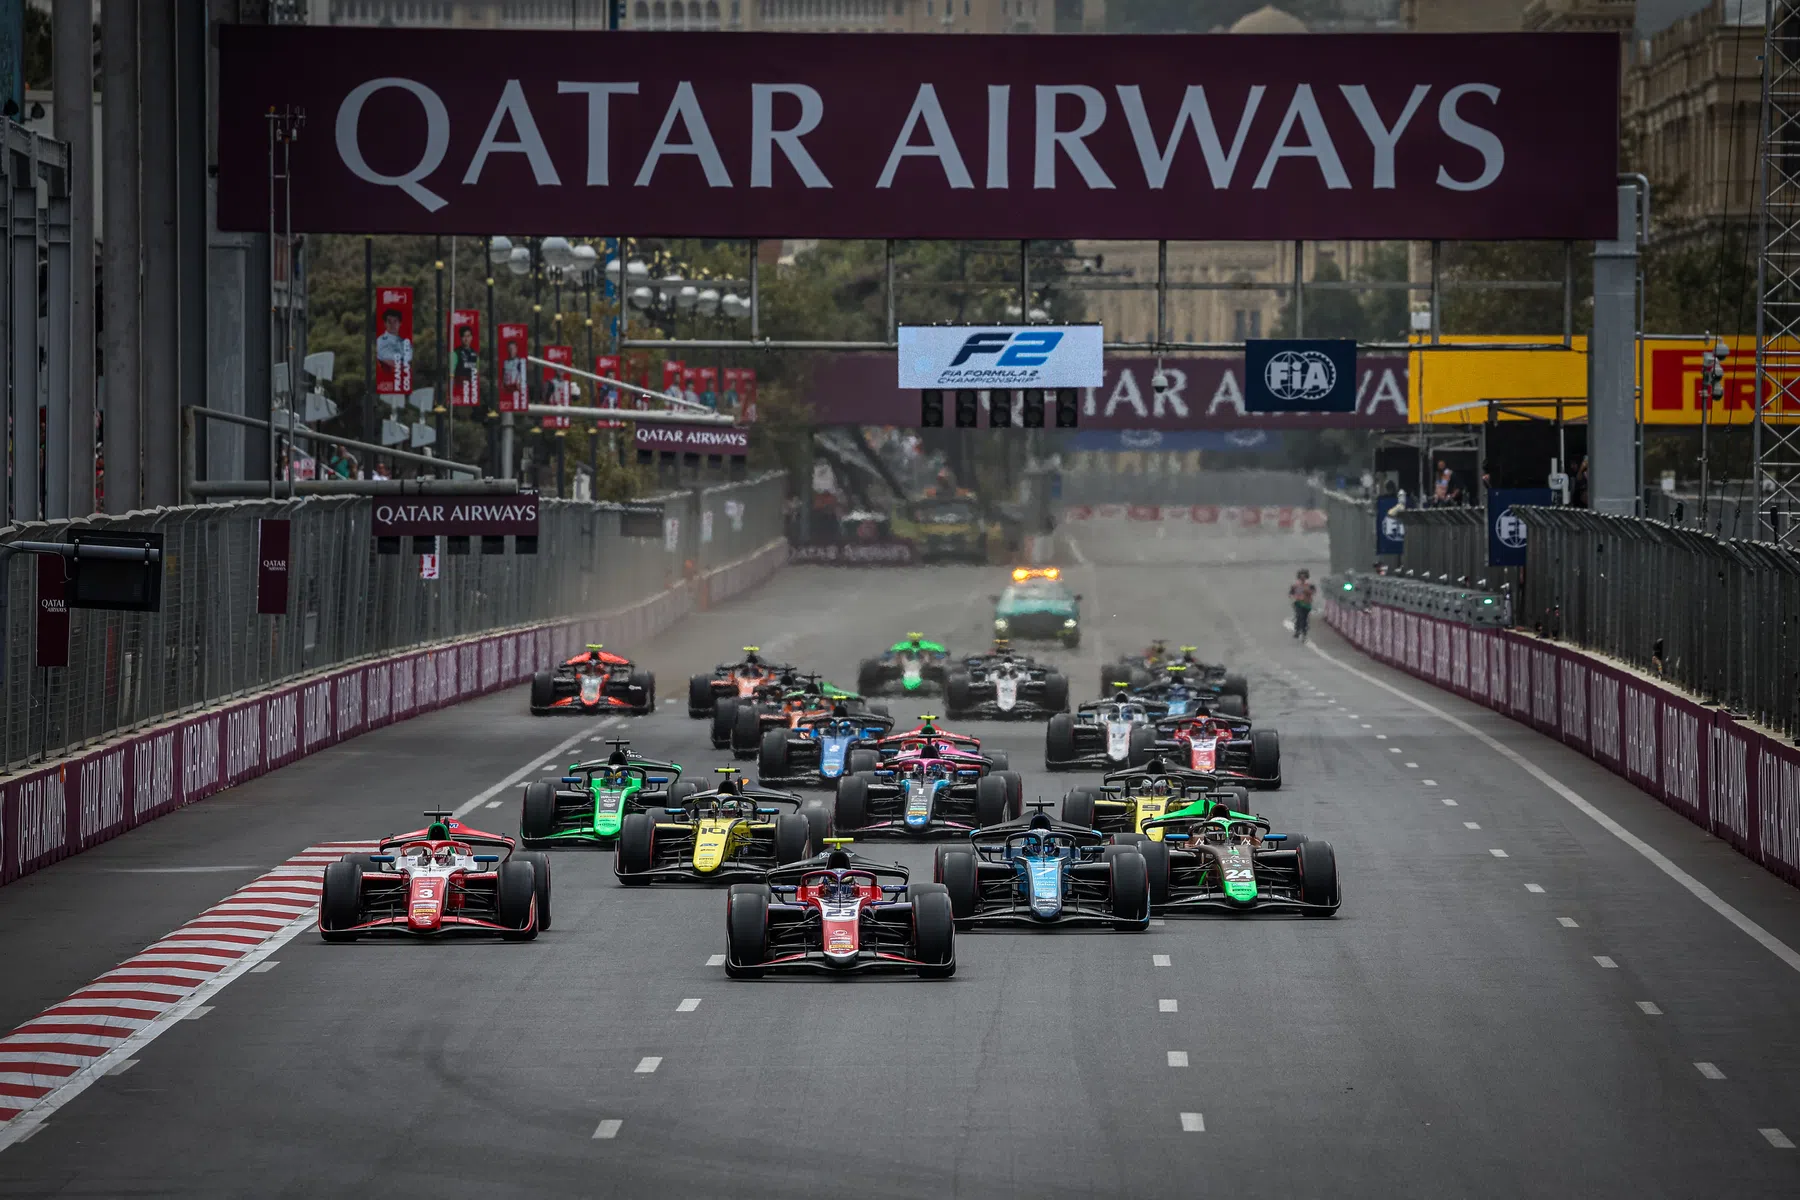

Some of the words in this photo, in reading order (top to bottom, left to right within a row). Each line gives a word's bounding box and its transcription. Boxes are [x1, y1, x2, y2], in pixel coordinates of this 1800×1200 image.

[335, 77, 834, 213] QATAR
[875, 82, 1505, 192] AIRWAYS
[949, 331, 1064, 367] F2
[636, 428, 683, 443] QATAR
[686, 431, 748, 446] AIRWAYS
[376, 505, 445, 525] QATAR
[450, 504, 537, 521] AIRWAYS
[263, 560, 286, 568] QATAR
[1035, 867, 1056, 876] 7
[1225, 869, 1254, 879] 24
[419, 889, 434, 898] 3
[826, 908, 857, 917] 23
